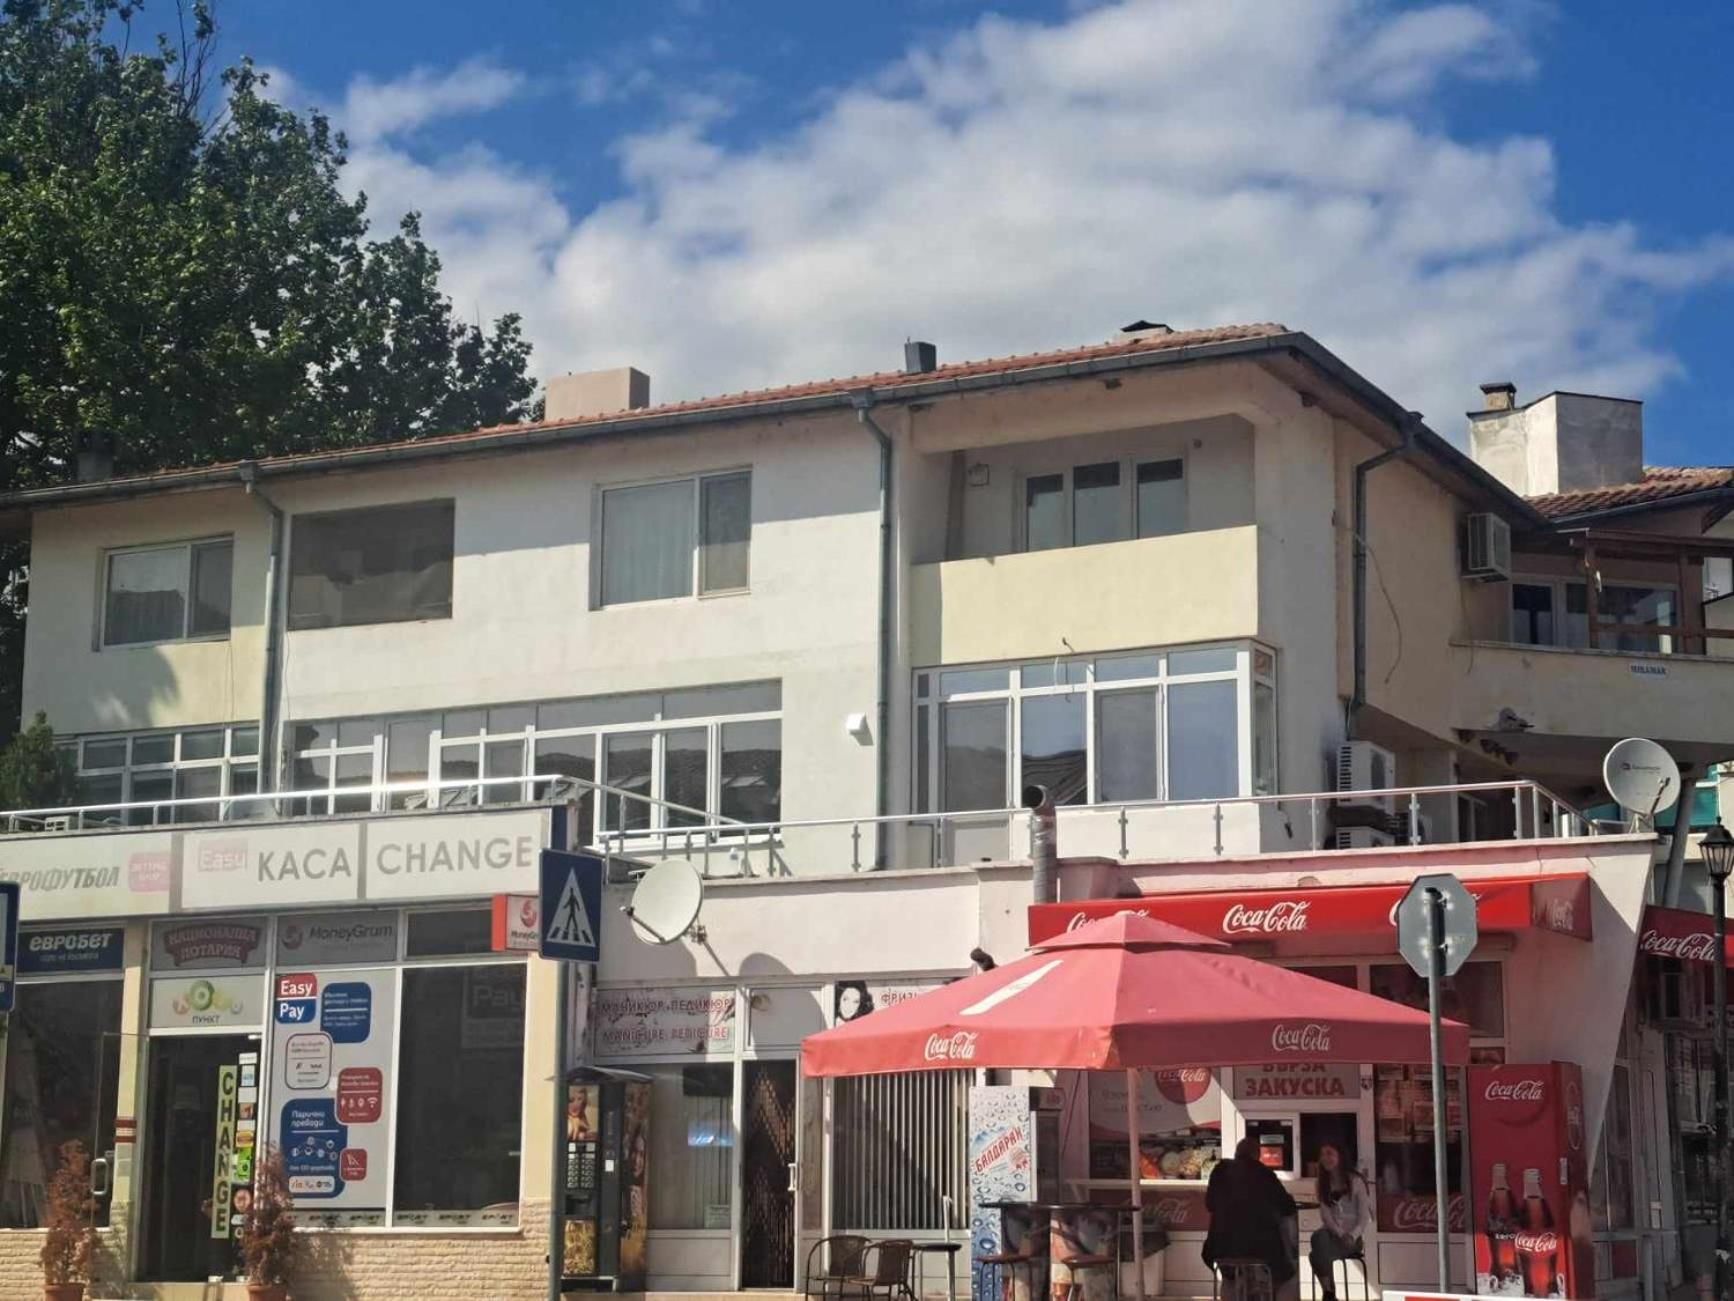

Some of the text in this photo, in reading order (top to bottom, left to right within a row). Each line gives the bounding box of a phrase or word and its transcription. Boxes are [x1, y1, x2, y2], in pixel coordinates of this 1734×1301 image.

[376, 836, 533, 875] CHANGE
[1222, 901, 1311, 934] Coca-Cola
[309, 923, 393, 942] MoneyGram
[281, 981, 313, 996] Easy
[192, 1016, 220, 1024] ПУНКТ
[280, 1004, 304, 1020] Pay
[924, 1031, 979, 1061] Coca-Cola
[1272, 1023, 1331, 1052] Coca-Cola
[1245, 1077, 1345, 1097] ЗАКУСКА
[1485, 1080, 1545, 1101] Coca-Cola
[214, 1071, 235, 1233] CHANGE
[975, 1126, 1023, 1174] БАЛДАРАН
